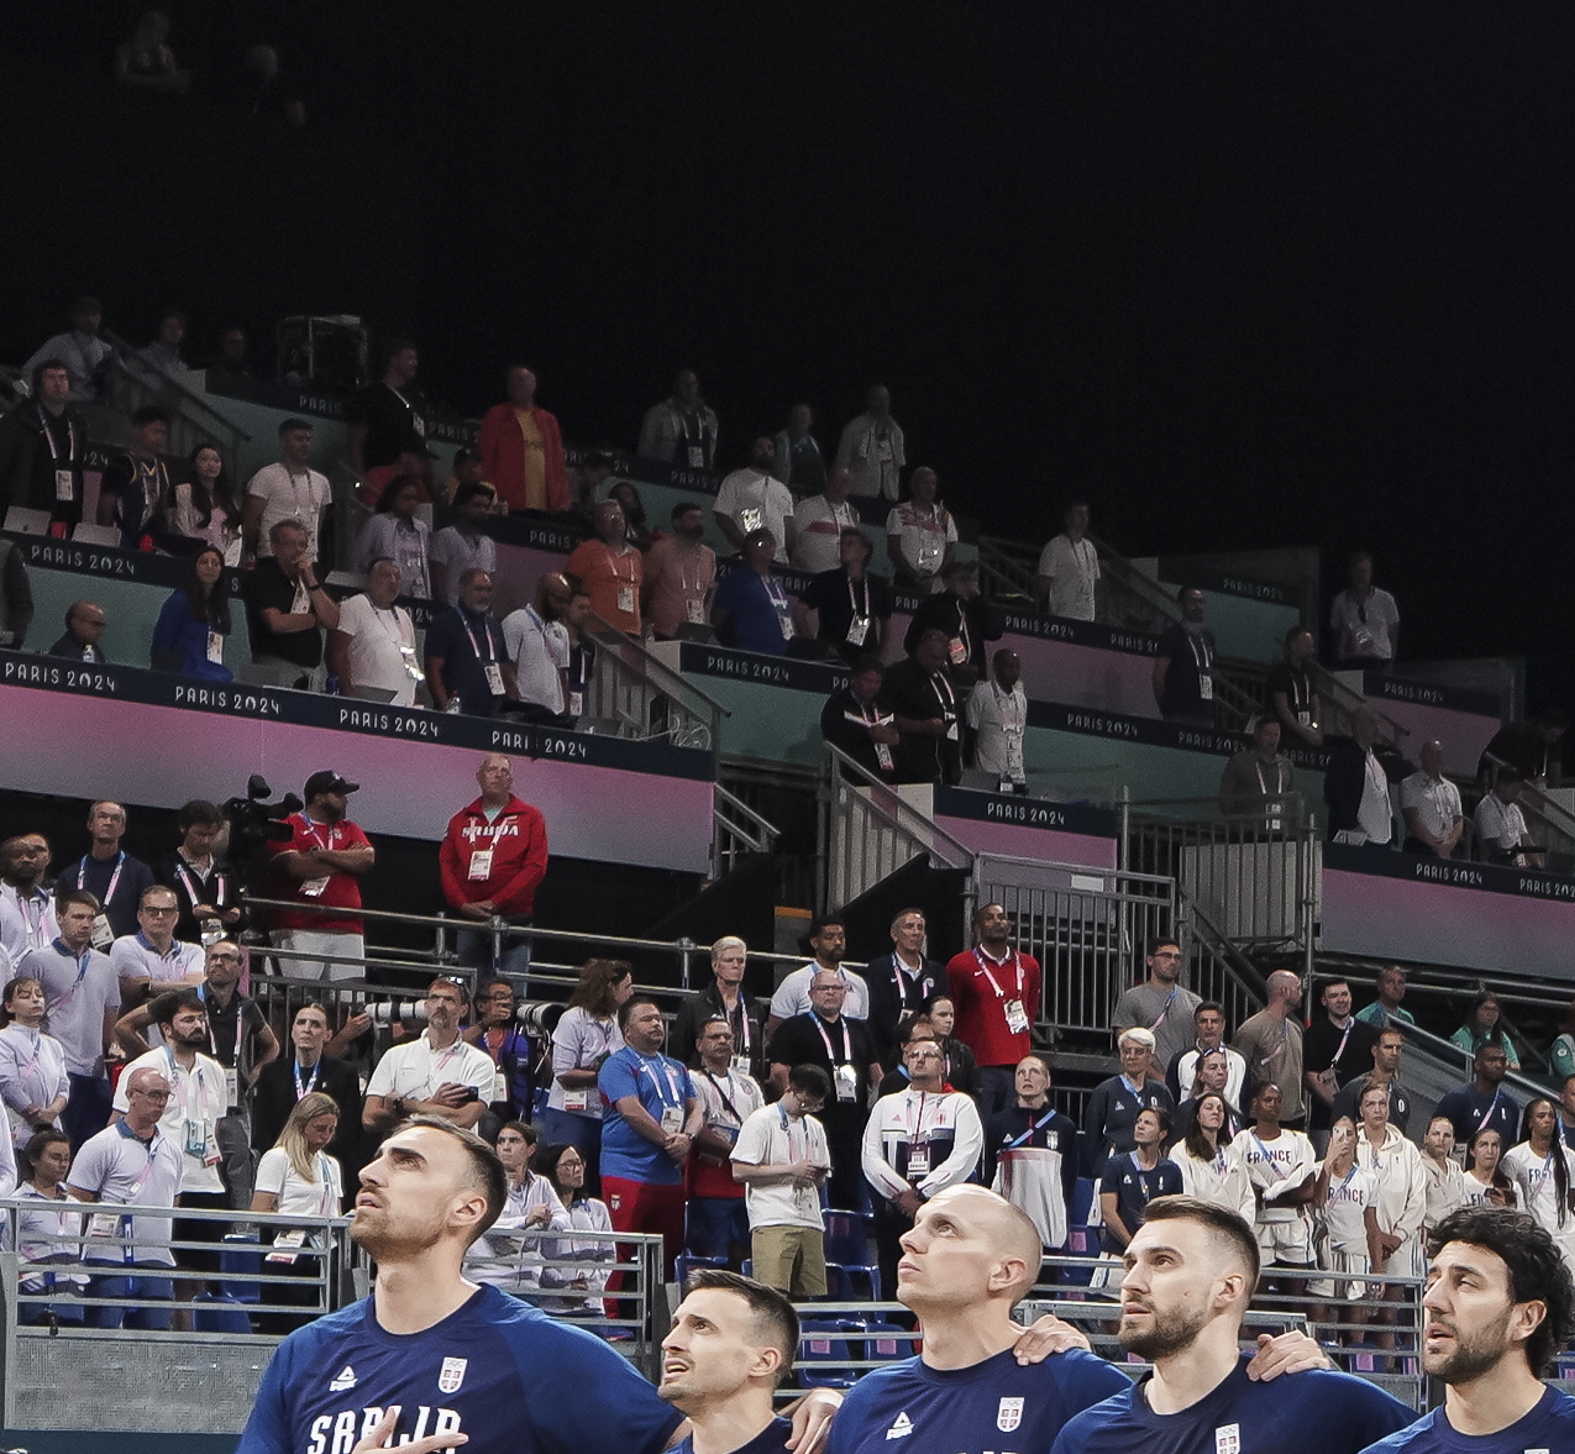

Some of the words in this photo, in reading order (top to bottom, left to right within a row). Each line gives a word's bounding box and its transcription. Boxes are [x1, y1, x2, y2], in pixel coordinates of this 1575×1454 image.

[32, 545, 83, 567] PARIS
[89, 556, 136, 575] 2024
[1004, 616, 1040, 633] PARIS
[1043, 622, 1076, 639] 2024
[1110, 634, 1147, 652] PARIS
[5, 662, 59, 686] PARIS
[67, 671, 116, 692] 2024
[707, 655, 747, 676] PARIS
[751, 663, 789, 681] 2024
[174, 685, 227, 708] PARIS
[233, 694, 281, 716] 2024
[1384, 682, 1416, 698] PARIS
[1418, 689, 1443, 703] 2024
[340, 708, 389, 731] PARIS
[395, 717, 440, 738] 2024
[1066, 713, 1103, 732] PARIS
[1106, 720, 1138, 737] 2024
[492, 731, 538, 752] PARI
[544, 738, 588, 758] 2024
[1178, 731, 1212, 750] PARIS
[987, 801, 1026, 821] PARIS
[1029, 808, 1065, 826] 2024
[1414, 863, 1450, 881] PARIS
[1452, 869, 1483, 885] 2024
[1519, 878, 1551, 895] PARIS
[1247, 1150, 1291, 1165] FRNCE
[1327, 1187, 1364, 1206] RNCE
